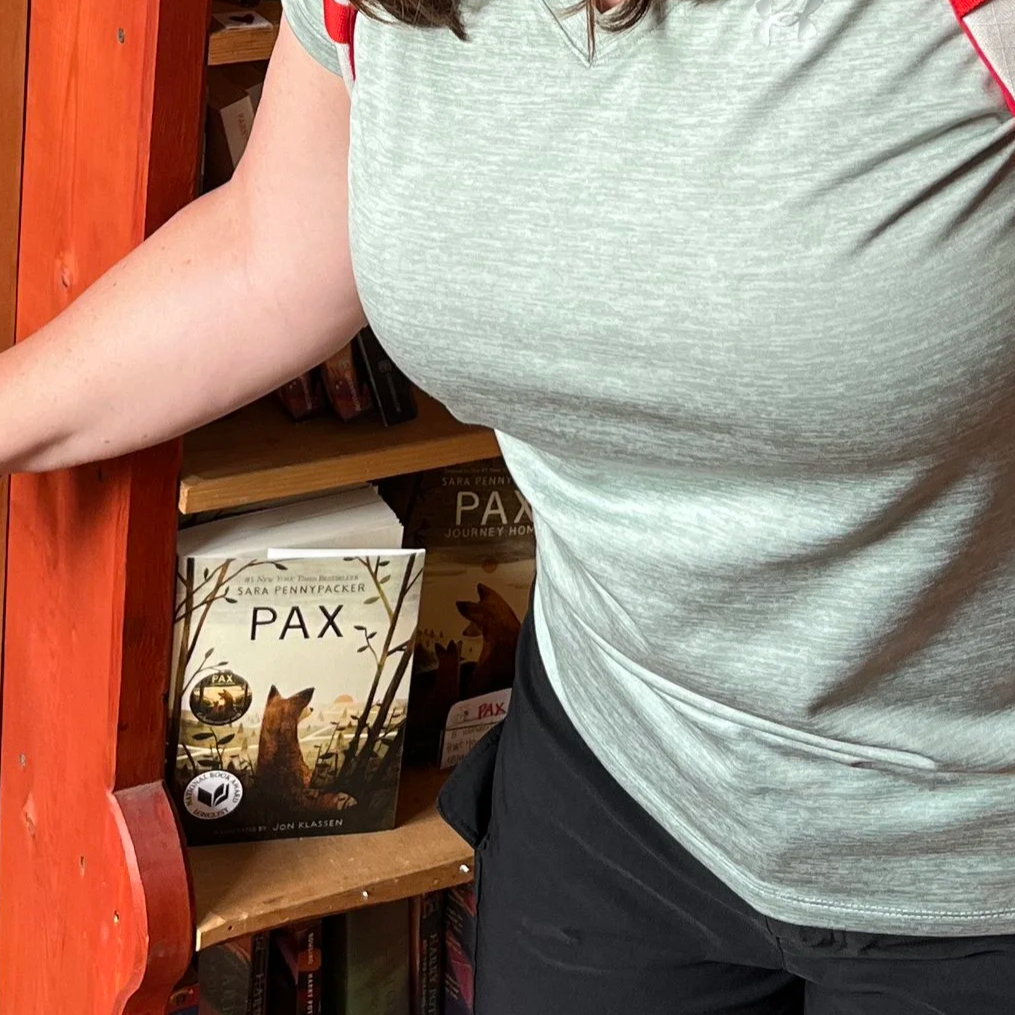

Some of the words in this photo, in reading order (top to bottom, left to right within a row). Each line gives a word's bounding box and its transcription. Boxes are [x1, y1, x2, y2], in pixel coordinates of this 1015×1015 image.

[442, 476, 471, 487] SARA
[455, 490, 533, 525] PAX
[444, 527, 505, 539] JOURNEY
[237, 586, 269, 596] SARA
[274, 584, 366, 595] PENNYPACKER
[250, 604, 344, 640] PAX
[211, 674, 234, 684] PAX
[478, 702, 507, 719] PAX
[209, 772, 230, 780] BOOK
[272, 822, 295, 832] JON
[298, 819, 343, 829] KLASSEN
